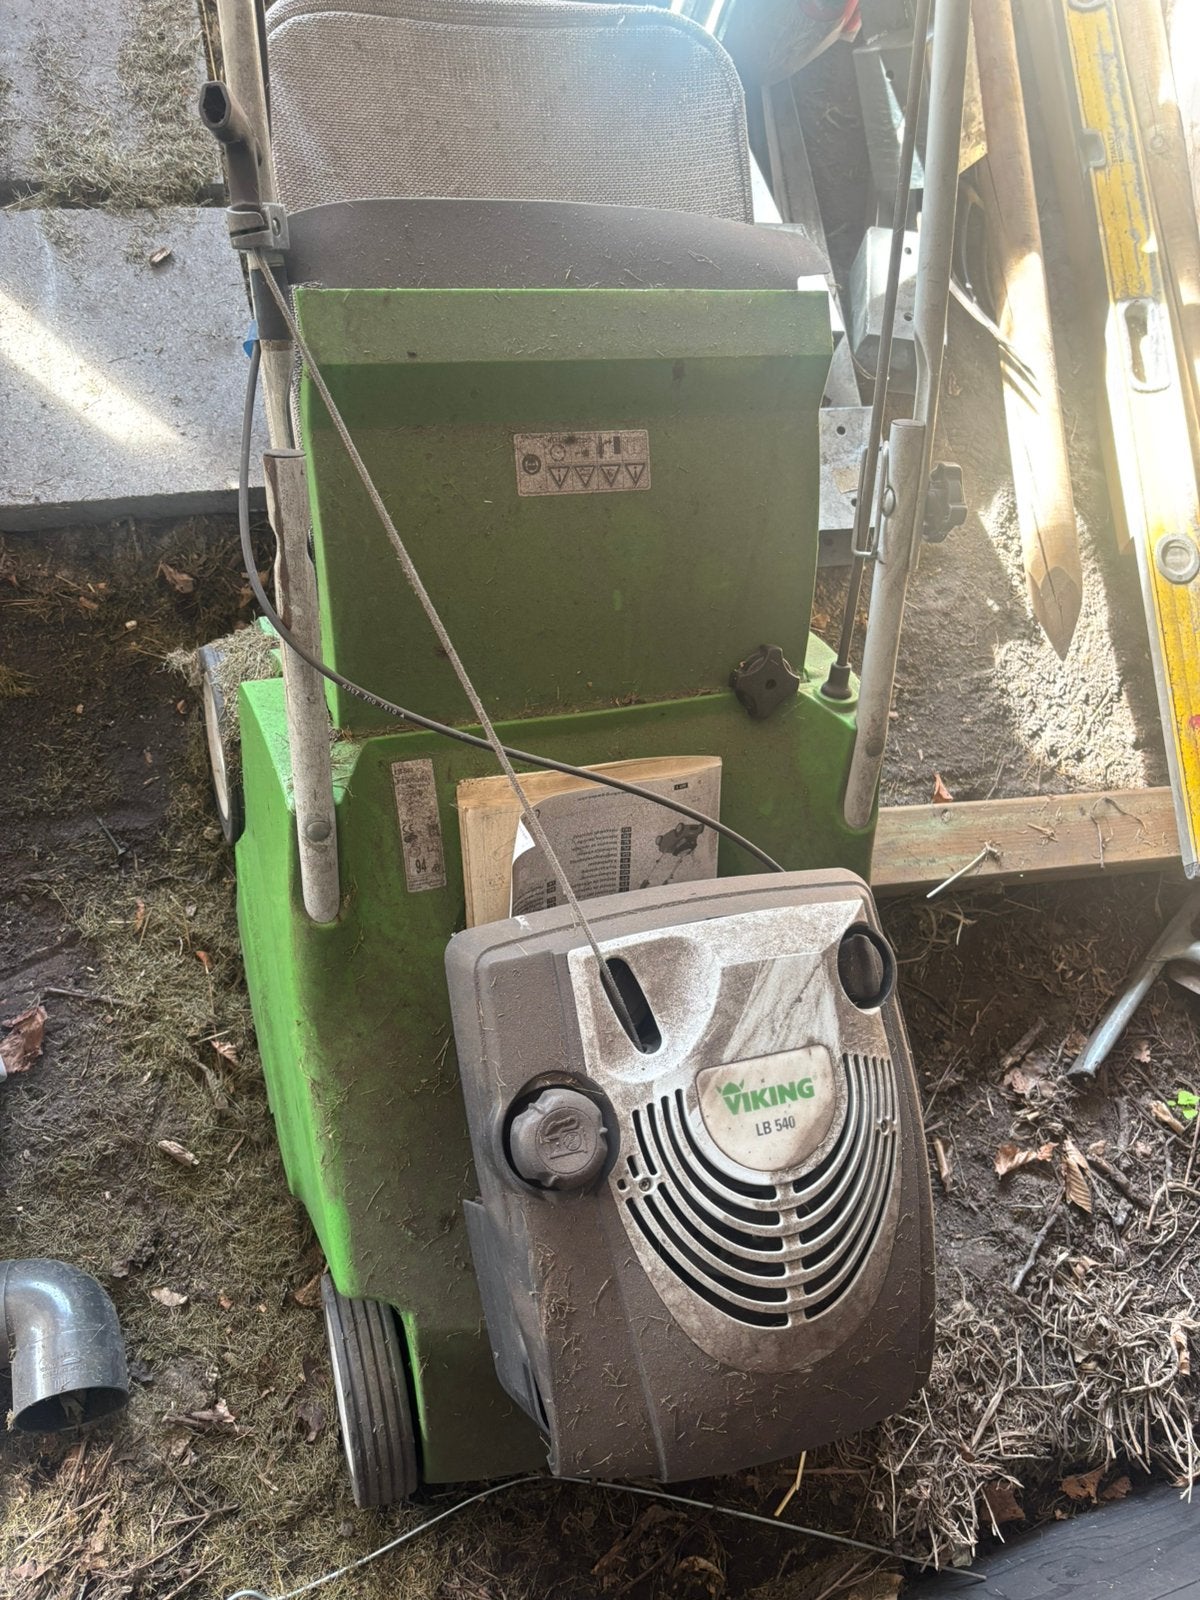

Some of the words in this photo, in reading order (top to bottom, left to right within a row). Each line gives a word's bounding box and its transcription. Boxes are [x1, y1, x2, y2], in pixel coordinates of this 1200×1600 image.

[415, 858, 427, 874] 94
[722, 1077, 816, 1116] VIKING
[755, 1120, 773, 1137] LB
[774, 1115, 796, 1132] 540
